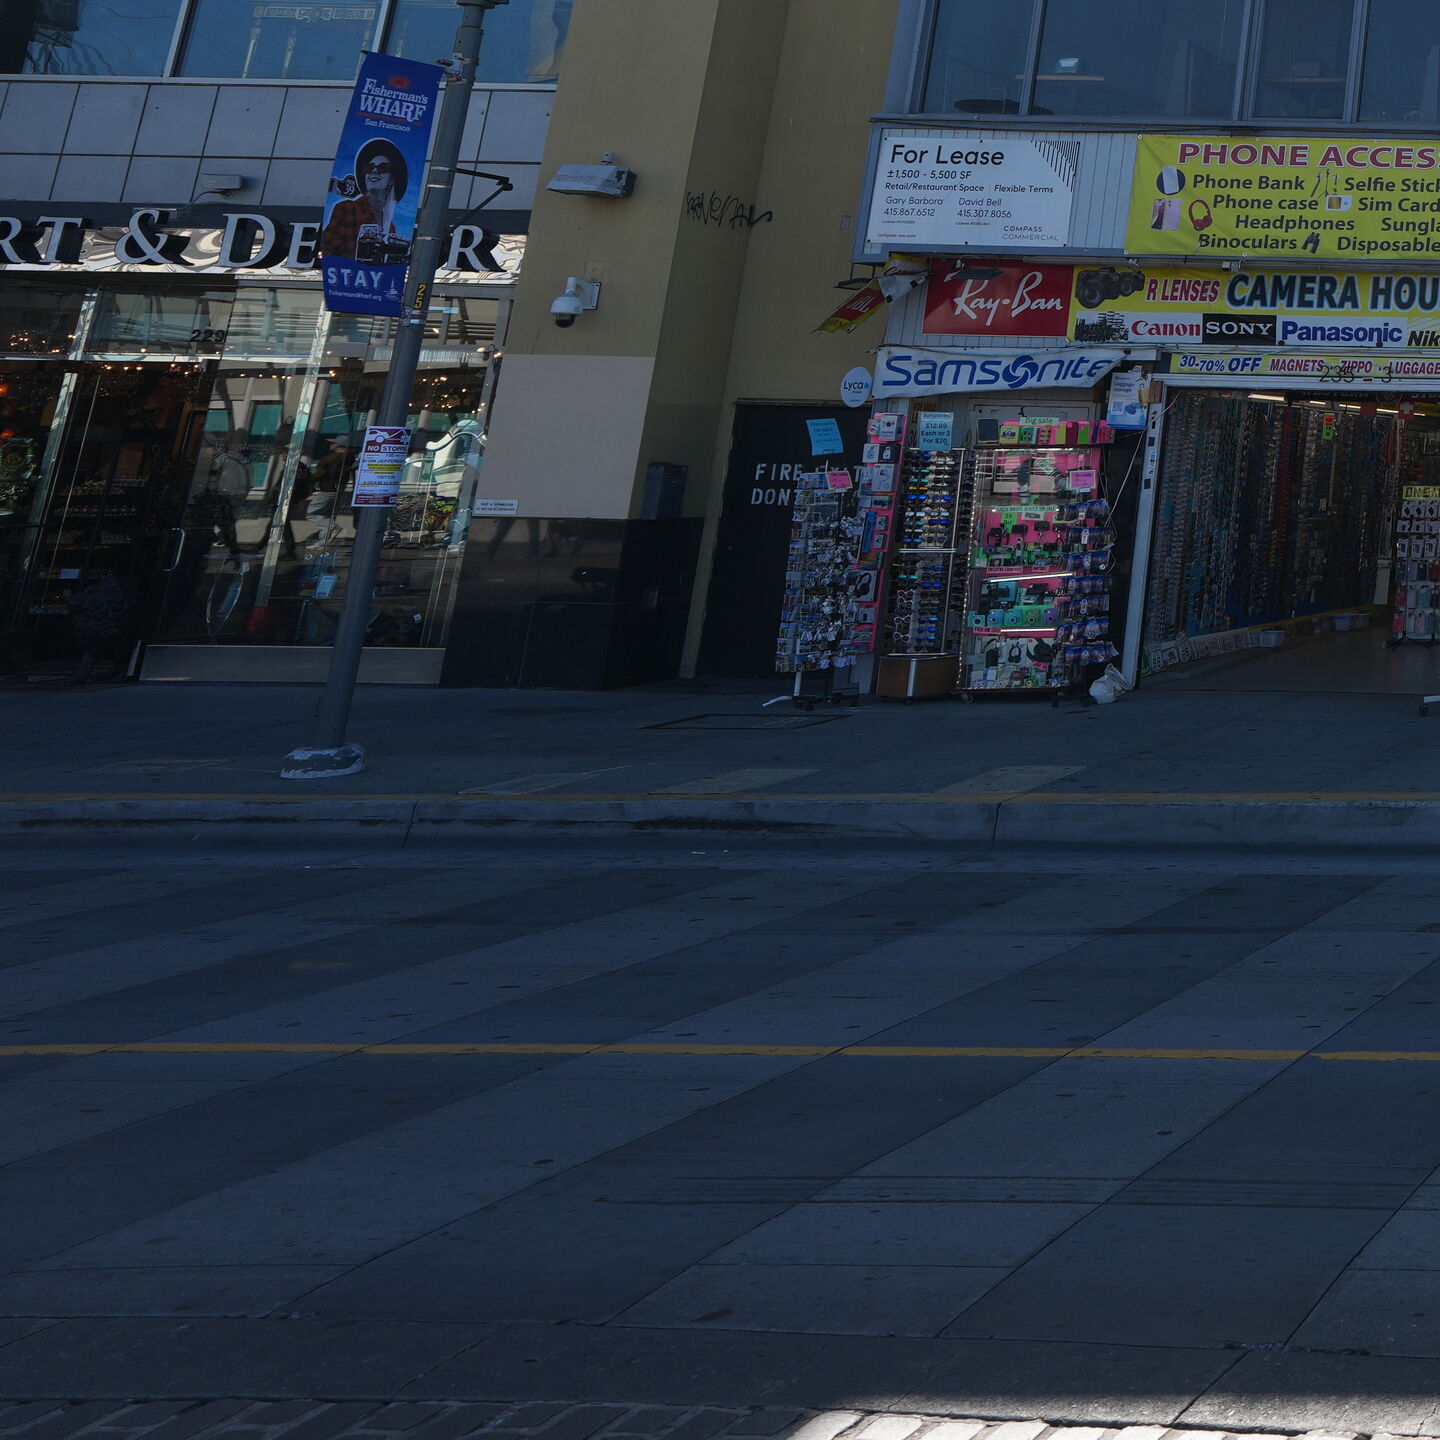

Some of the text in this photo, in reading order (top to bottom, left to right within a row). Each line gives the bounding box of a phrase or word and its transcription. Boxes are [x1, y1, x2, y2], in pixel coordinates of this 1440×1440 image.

[362, 77, 428, 105] Fisherman's
[360, 94, 427, 123] WHARF
[365, 118, 411, 132] San Francisco
[891, 145, 1004, 165] For Lease
[1178, 142, 1308, 167] PHONE
[930, 170, 957, 180] 5,500
[960, 170, 972, 180] SF
[1193, 173, 1305, 190] Phone Bank
[344, 185, 355, 195] 39
[885, 183, 1054, 193] Retail/Restaurant Space Flexible Terms
[1344, 177, 1397, 193] Selfie
[886, 196, 906, 206] Gary
[959, 197, 1002, 207] David Bell
[1213, 194, 1319, 212] Phone case
[1358, 197, 1389, 212] Sim
[1395, 197, 1440, 213] Card
[884, 208, 935, 217] 415.867.6512
[957, 209, 1012, 219] 415.307.8056
[1004, 225, 1042, 233] COMPASS
[1236, 215, 1355, 234] Headphones
[115, 208, 172, 265] &
[218, 212, 505, 273] DER
[1003, 233, 1059, 241] COMMERCIAL
[1198, 233, 1297, 250] Binoculars
[1337, 236, 1440, 255] Disposable
[327, 267, 384, 289] STAY
[1146, 278, 1157, 302] R
[1160, 277, 1220, 304] LENSES
[1227, 275, 1358, 310] CAMERA
[190, 328, 228, 344] 229
[1131, 320, 1201, 336] Canon
[1205, 320, 1273, 335] SONY
[1281, 320, 1402, 347] Panasonic
[1179, 355, 1225, 374] 30-70%
[1228, 357, 1262, 372] OFF
[1269, 358, 1325, 373] MAGNETS
[1339, 359, 1373, 374] ZIPPO
[843, 380, 864, 392] Lyca
[755, 463, 802, 481] FIRE
